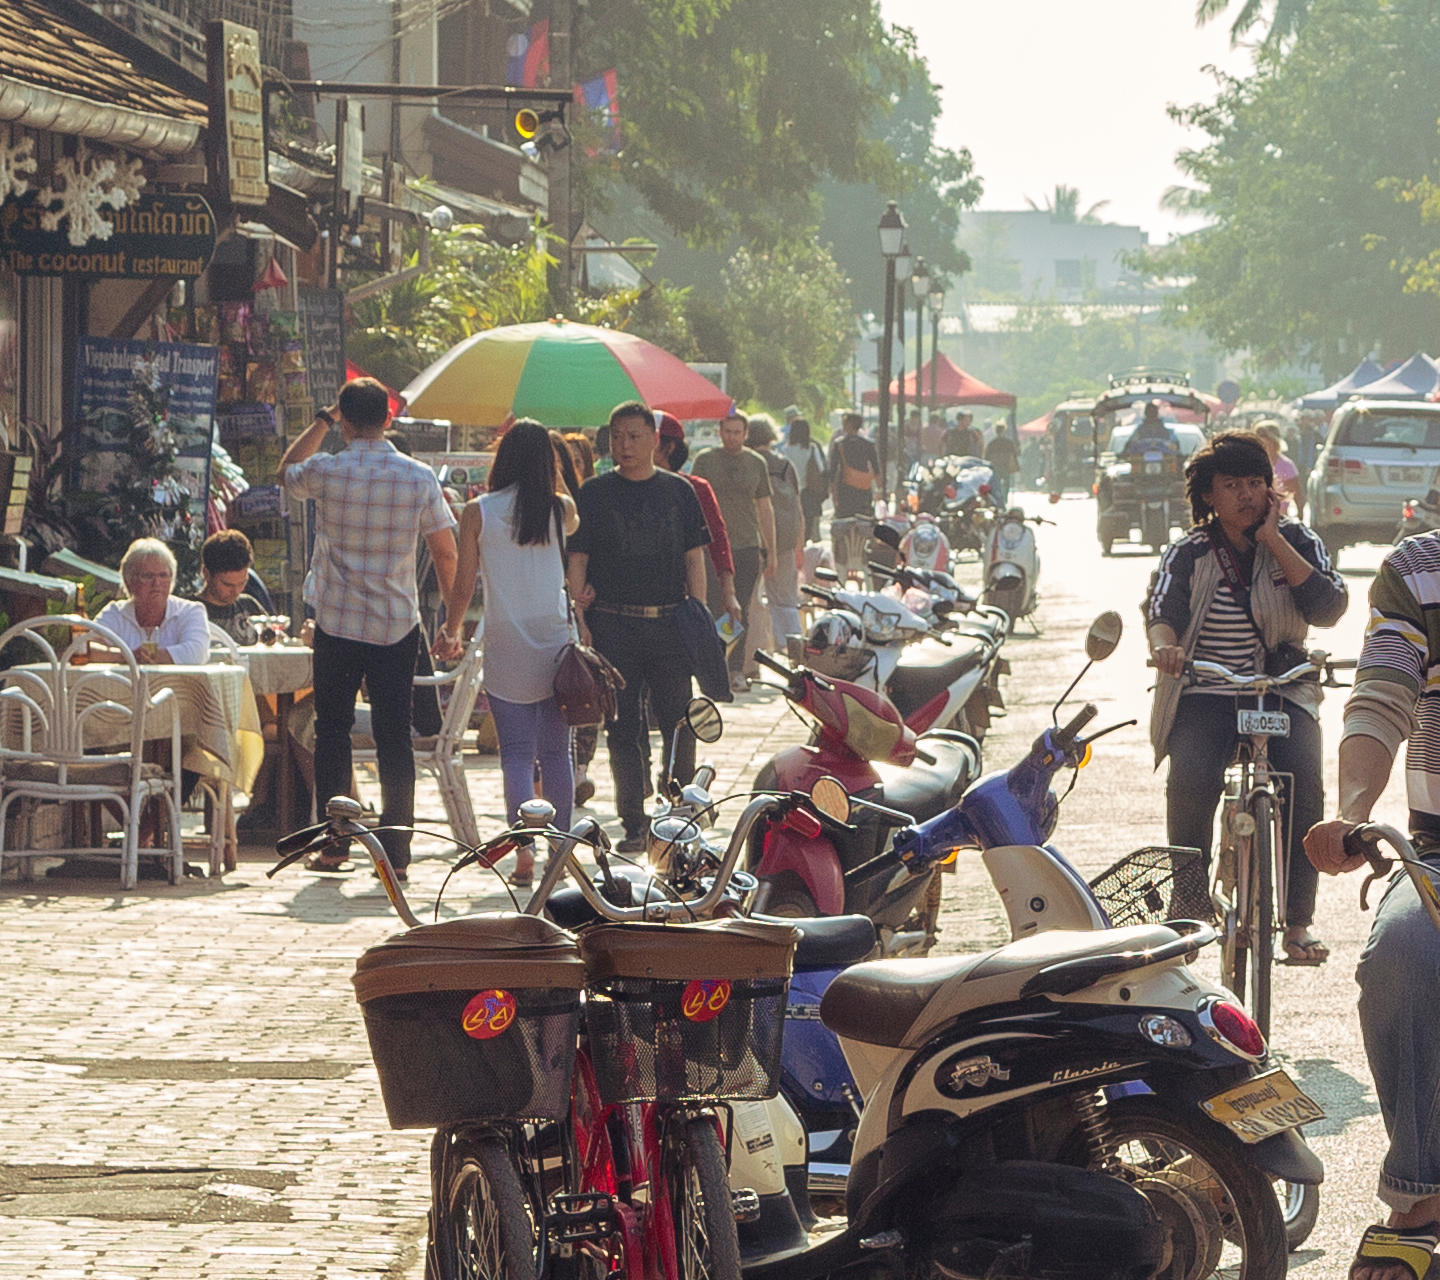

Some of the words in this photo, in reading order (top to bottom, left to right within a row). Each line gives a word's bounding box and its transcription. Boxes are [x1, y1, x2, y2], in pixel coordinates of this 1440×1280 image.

[9, 250, 34, 270] The
[38, 251, 126, 273] coconut
[132, 257, 205, 276] restaurant
